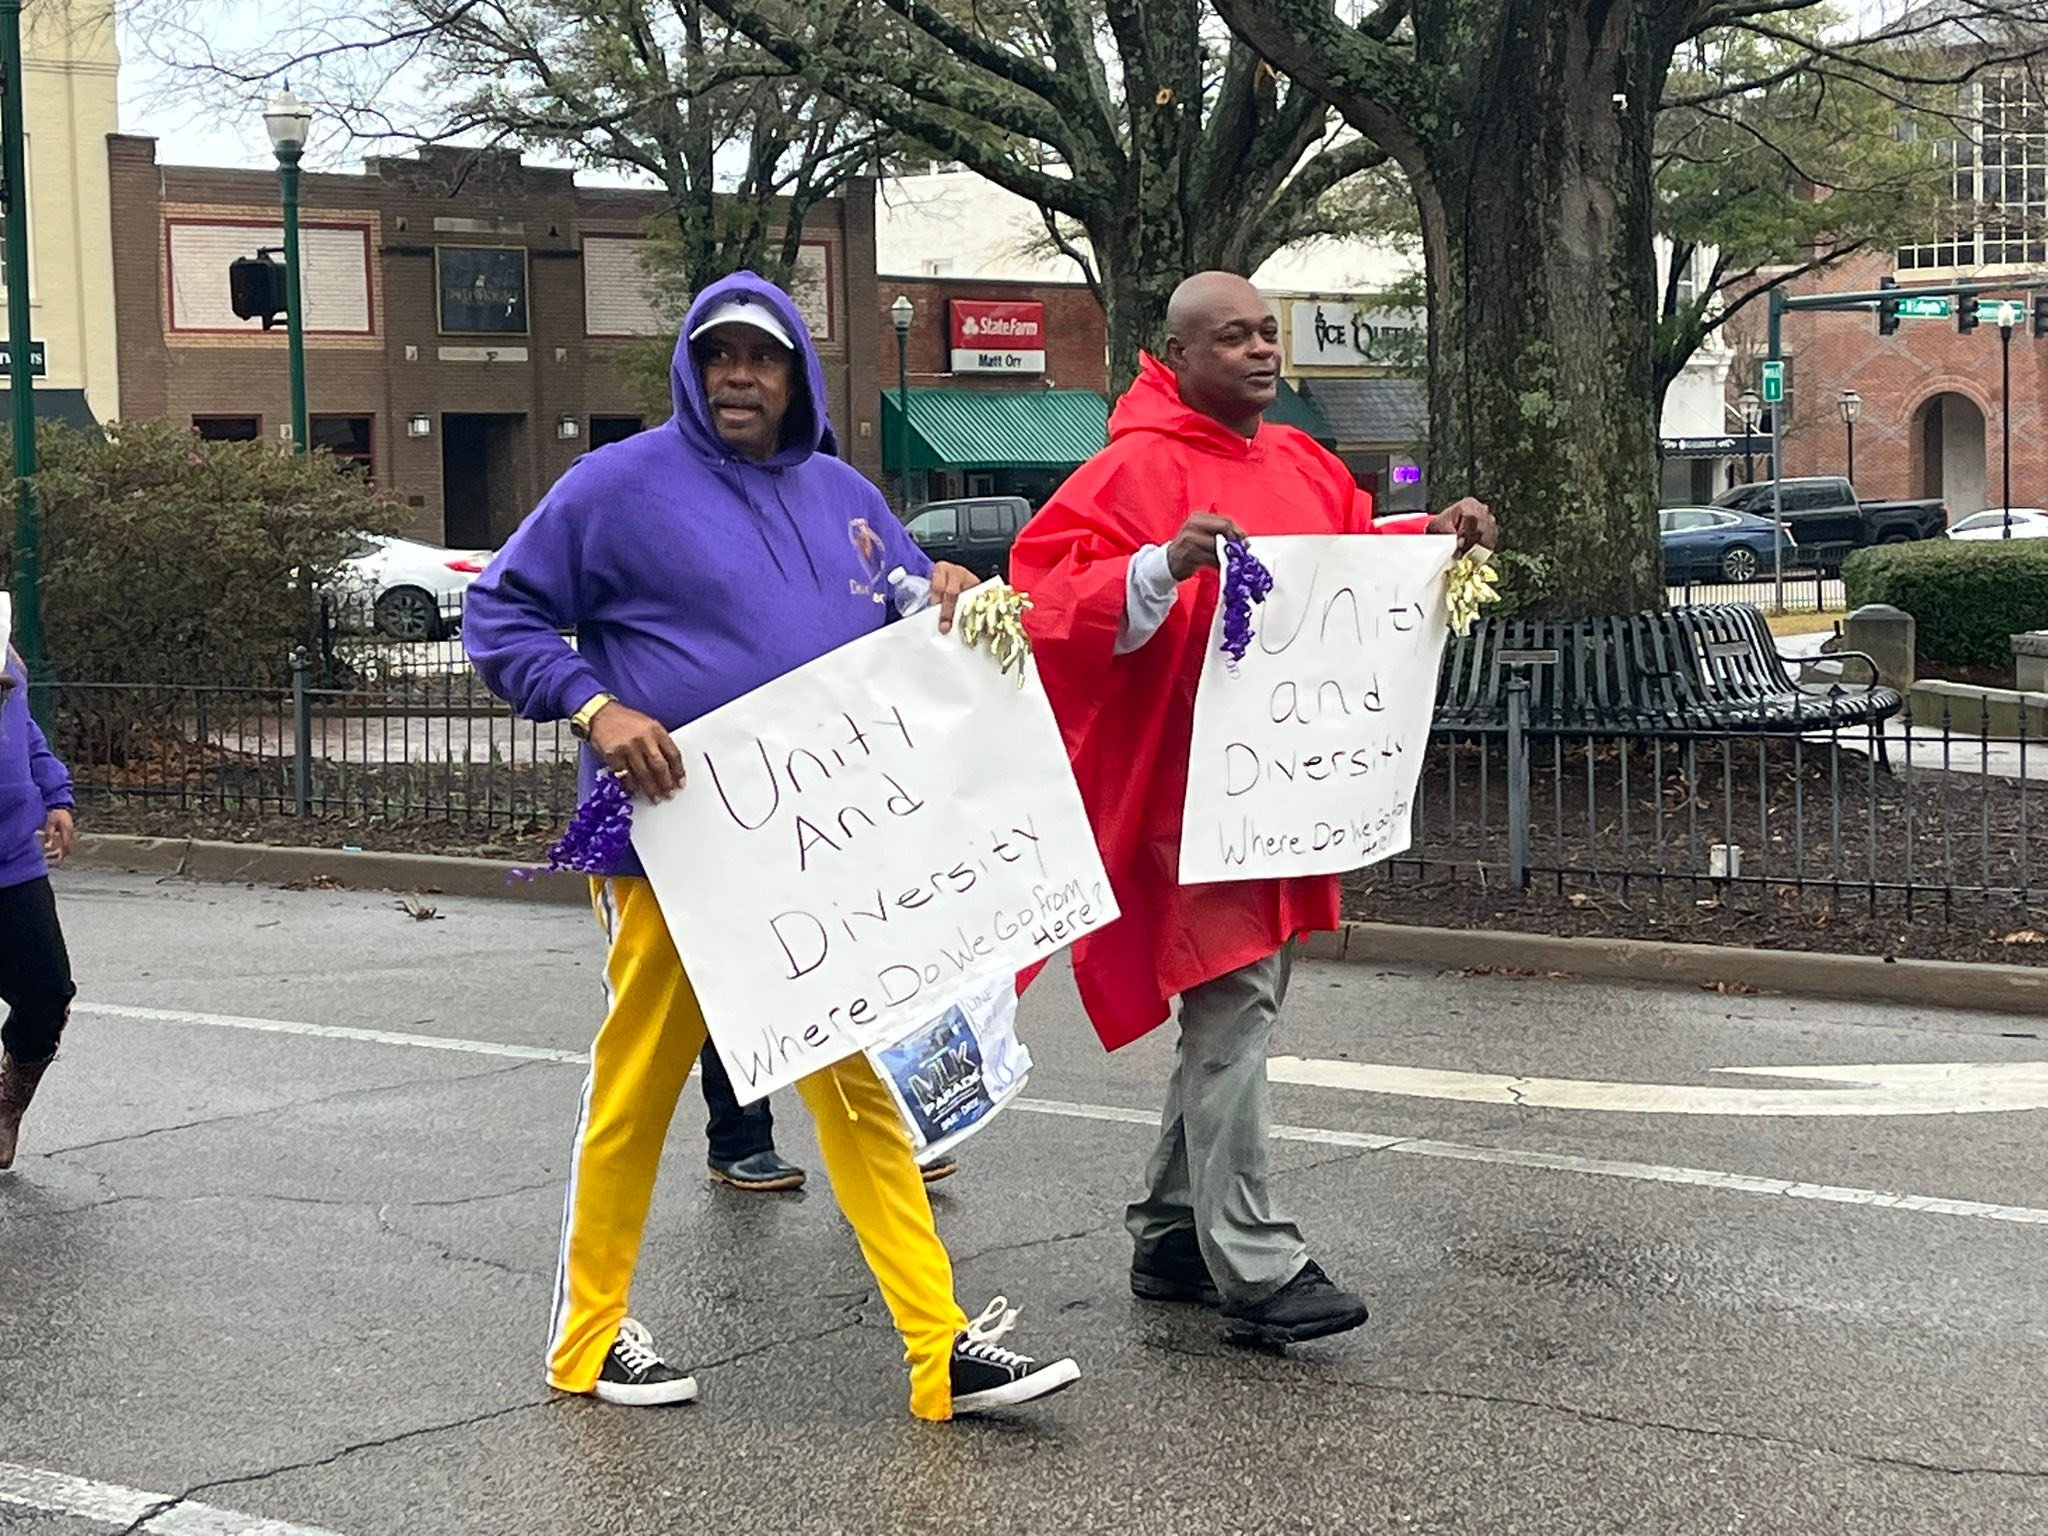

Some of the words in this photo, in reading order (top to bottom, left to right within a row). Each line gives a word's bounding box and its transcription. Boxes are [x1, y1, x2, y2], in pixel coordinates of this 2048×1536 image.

[979, 354, 1002, 368] Matt
[1005, 354, 1023, 368] Orr
[1259, 561, 1425, 657] Unity
[1269, 672, 1386, 725] and
[702, 705, 915, 831] Unity
[1224, 733, 1406, 797] Diversity
[795, 771, 925, 873] And
[1218, 815, 1305, 866] Where
[1311, 821, 1346, 851] Do
[768, 813, 1048, 981] Diversity
[730, 997, 877, 1088] Where
[876, 964, 941, 1008] Do
[939, 926, 995, 973] We
[993, 909, 1034, 942] Go
[907, 1040, 978, 1110] MLK
